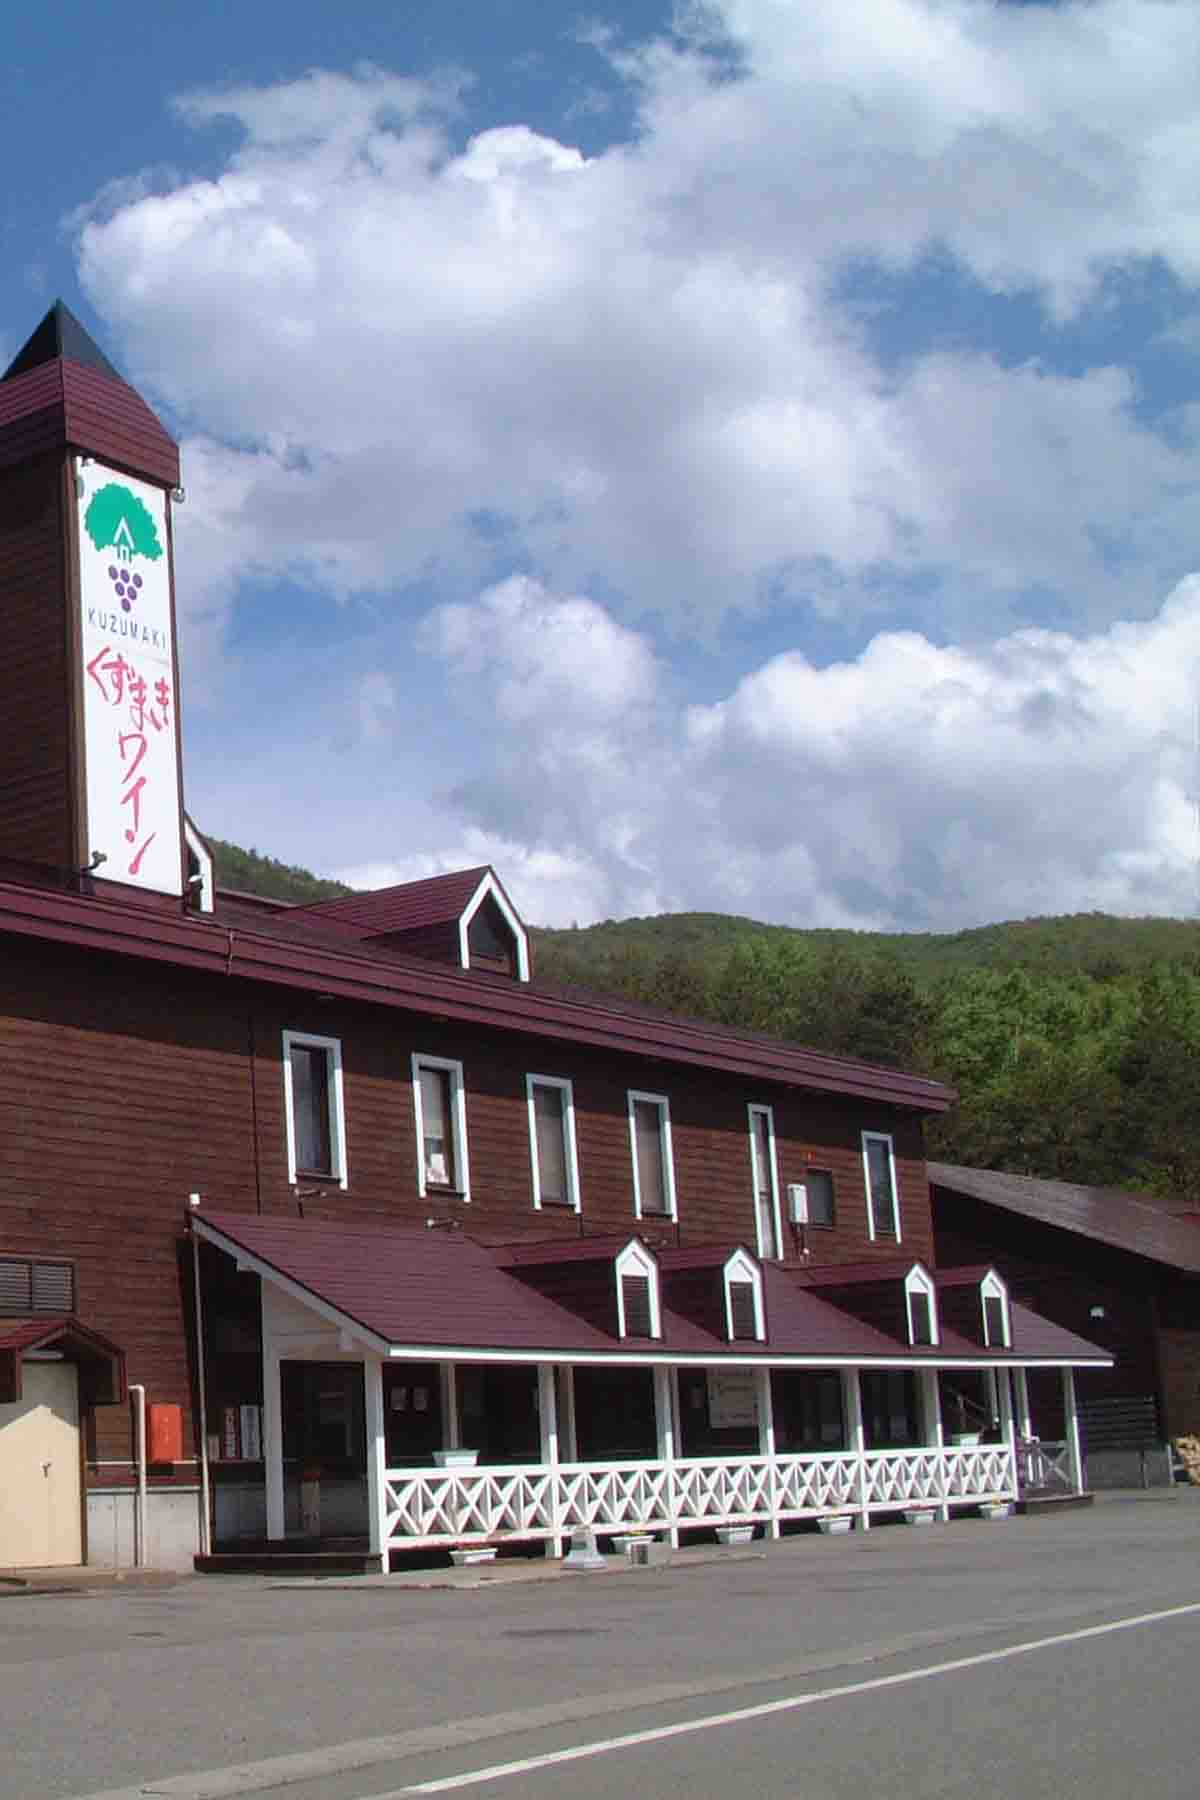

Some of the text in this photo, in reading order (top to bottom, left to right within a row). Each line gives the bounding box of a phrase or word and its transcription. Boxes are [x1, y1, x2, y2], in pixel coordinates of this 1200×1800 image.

[88, 607, 166, 649] KUZUMAKI
[86, 645, 169, 732] くずまき
[119, 731, 157, 876] ワイン
